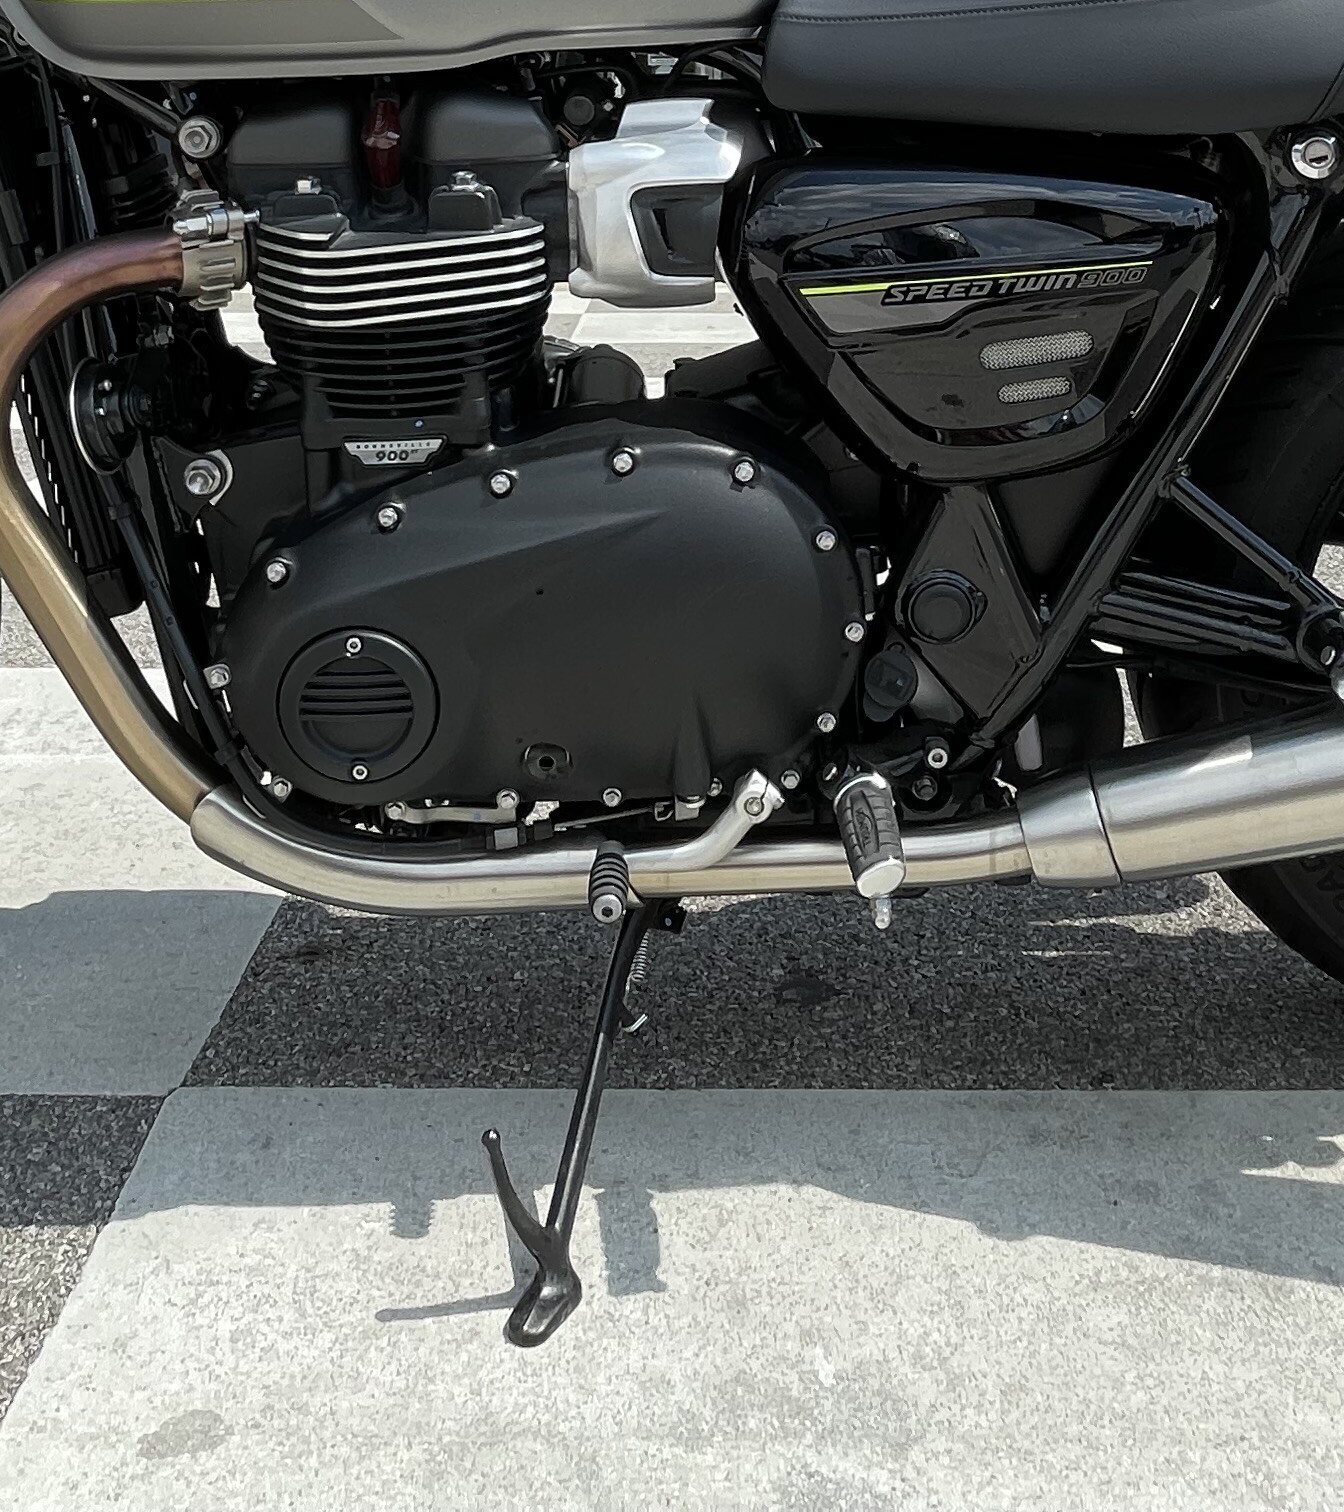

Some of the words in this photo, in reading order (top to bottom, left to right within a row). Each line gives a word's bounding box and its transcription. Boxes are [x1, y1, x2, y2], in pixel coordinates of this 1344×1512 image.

[885, 279, 994, 303] SPEED
[998, 273, 1078, 296] TWIN
[1077, 266, 1148, 289] 900
[375, 450, 409, 462] 900
